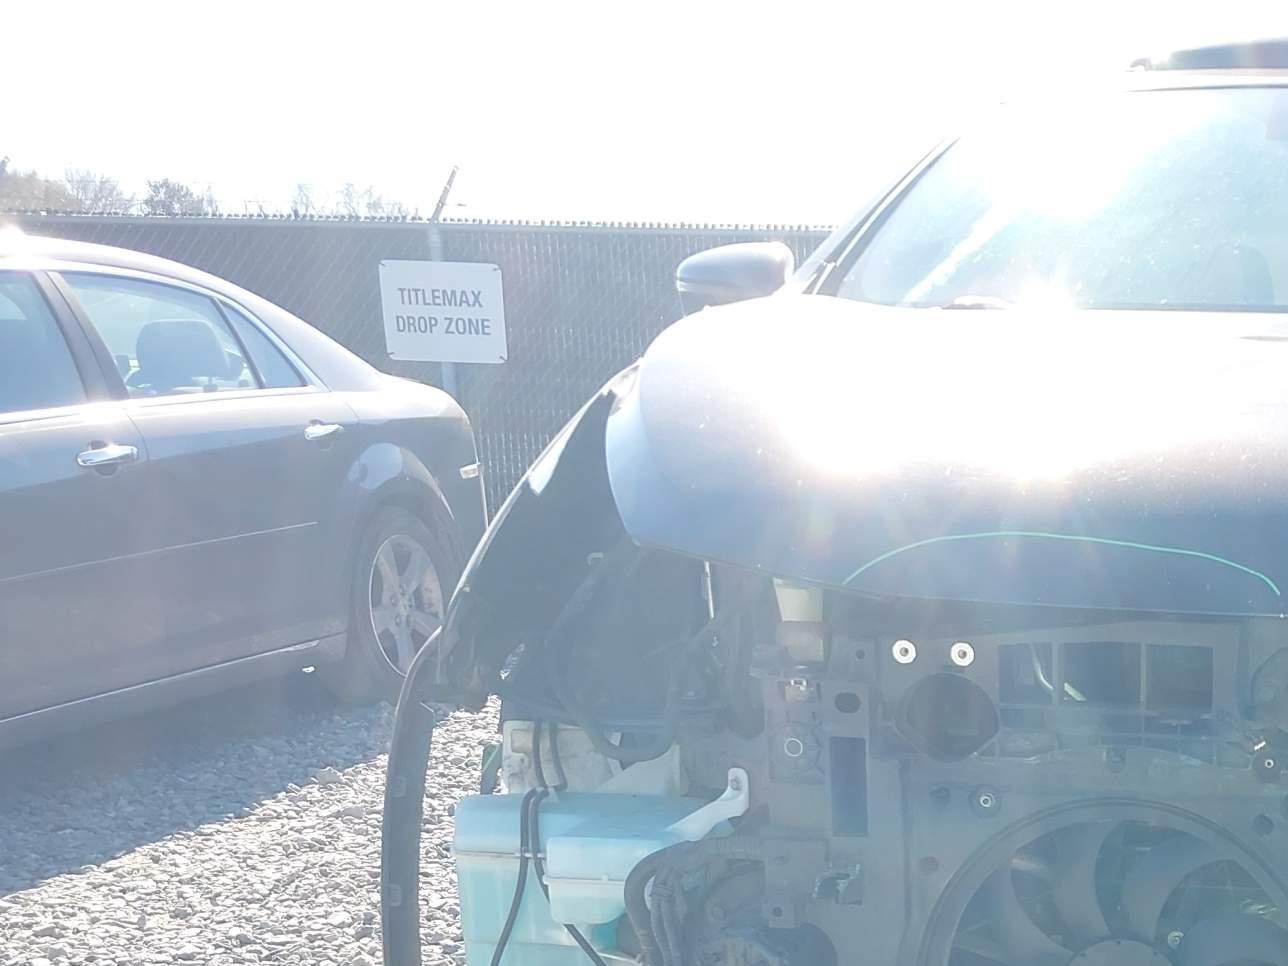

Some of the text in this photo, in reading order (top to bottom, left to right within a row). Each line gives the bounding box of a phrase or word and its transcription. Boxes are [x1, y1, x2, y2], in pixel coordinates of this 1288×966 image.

[397, 287, 483, 308] TITLEMAX
[396, 315, 492, 336] DROP ZONE
